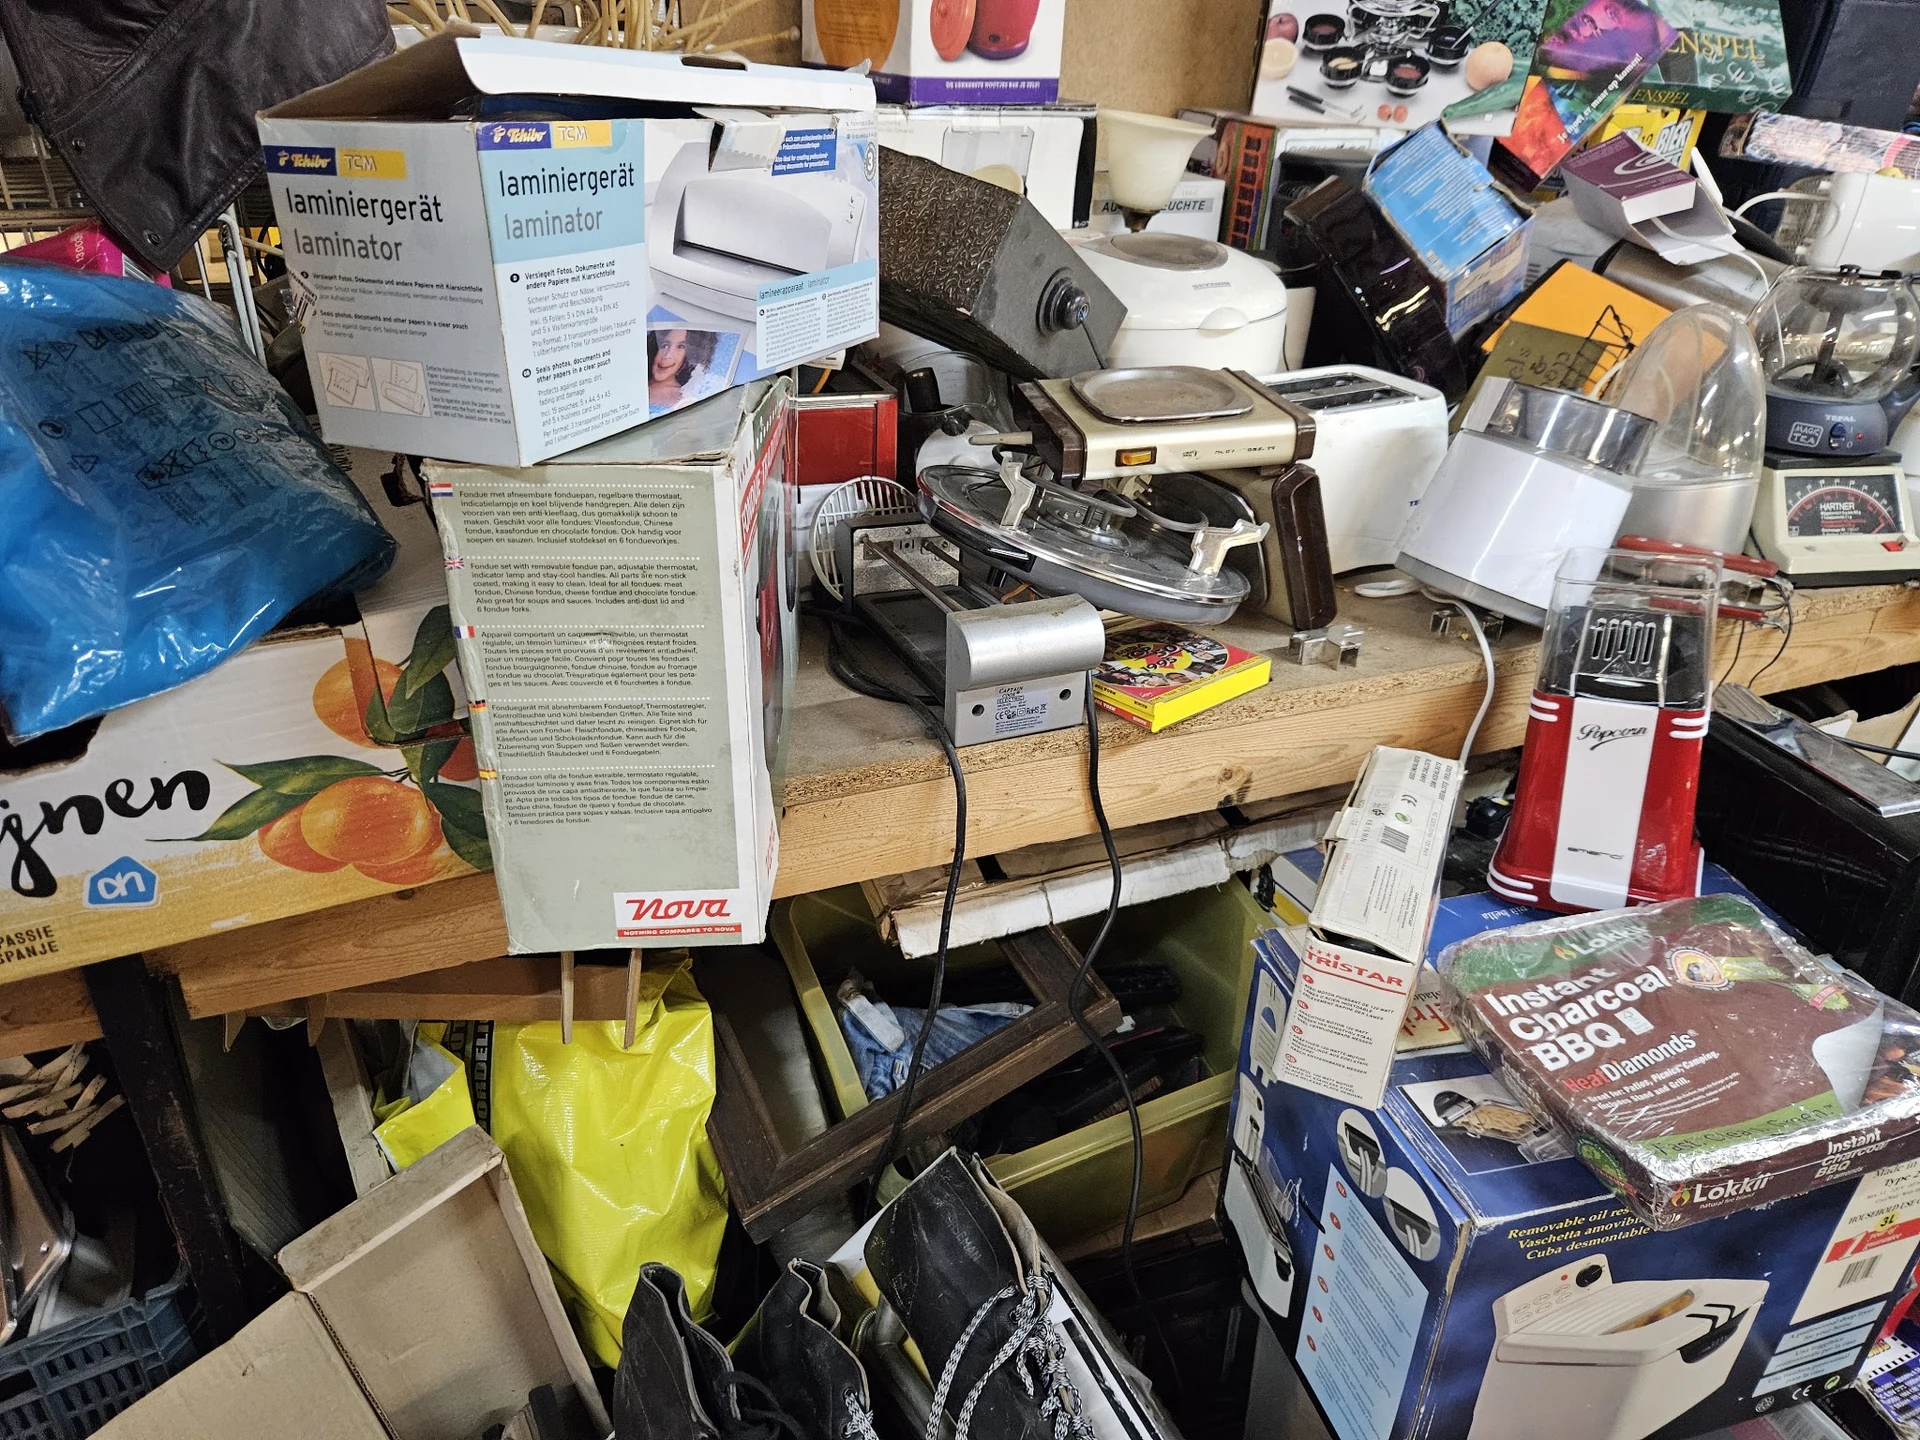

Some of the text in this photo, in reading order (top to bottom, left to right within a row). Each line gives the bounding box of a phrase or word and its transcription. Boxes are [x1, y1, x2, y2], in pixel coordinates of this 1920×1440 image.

[1557, 128, 1569, 144] Je
[1567, 111, 1586, 137] moet
[1590, 89, 1610, 110] maar
[1607, 79, 1619, 96] op
[1615, 52, 1644, 82] komen!
[507, 126, 587, 143] Tchibo TCM
[1657, 118, 1693, 153] BIER
[291, 154, 377, 171] Tchibo TCM
[867, 152, 873, 171] 3
[499, 162, 635, 196] laminiergerät
[285, 187, 443, 226] laminiergerät
[504, 207, 603, 240] laminator
[294, 228, 403, 261] laminator
[575, 262, 605, 273] Dokumente
[526, 280, 546, 290] andere
[548, 277, 569, 288] Papiere
[570, 274, 581, 282] mit
[536, 364, 551, 374] Seals
[573, 352, 601, 366] documents
[602, 349, 611, 357] and
[536, 374, 552, 383] other
[553, 369, 571, 380] papers
[597, 358, 611, 368] pouch
[1824, 414, 1857, 422] TEFAL
[1793, 433, 1816, 444] TEA
[1794, 425, 1820, 436] MAGIC
[460, 500, 518, 508] indicatielampje
[554, 491, 597, 499] fonduepan,
[598, 492, 634, 500] regelbare
[635, 492, 682, 500] thermostaat,
[597, 510, 640, 518] gemakkelijk
[1820, 502, 1855, 511] HARTNER
[465, 527, 494, 535] fondue,
[625, 537, 679, 545] fonduevorkjes.
[617, 563, 655, 571] adjustable
[1142, 656, 1178, 672] 1995
[1577, 724, 1647, 746] Popcorn
[626, 898, 731, 921] Nova
[1480, 908, 1511, 921] bella
[1484, 967, 1618, 1016] Instant
[1509, 965, 1672, 1041] Charcoal
[1532, 1022, 1627, 1072] BBQ
[474, 1020, 490, 1129] ORDELI
[1624, 1078, 1653, 1095] Patios,
[1683, 1050, 1720, 1070] Camping.
[1631, 1090, 1653, 1102] Stand
[1654, 1085, 1670, 1096] and
[1827, 1128, 1882, 1155] Instant
[1814, 1160, 1852, 1179] BBQ
[1693, 1172, 1770, 1203] Lokkii
[1700, 1198, 1723, 1209] natural
[1507, 1216, 1585, 1240] Removable
[1588, 1209, 1609, 1222] oil
[1518, 1227, 1581, 1250] Vaschetta
[1526, 1226, 1650, 1260] Cuba desmontable
